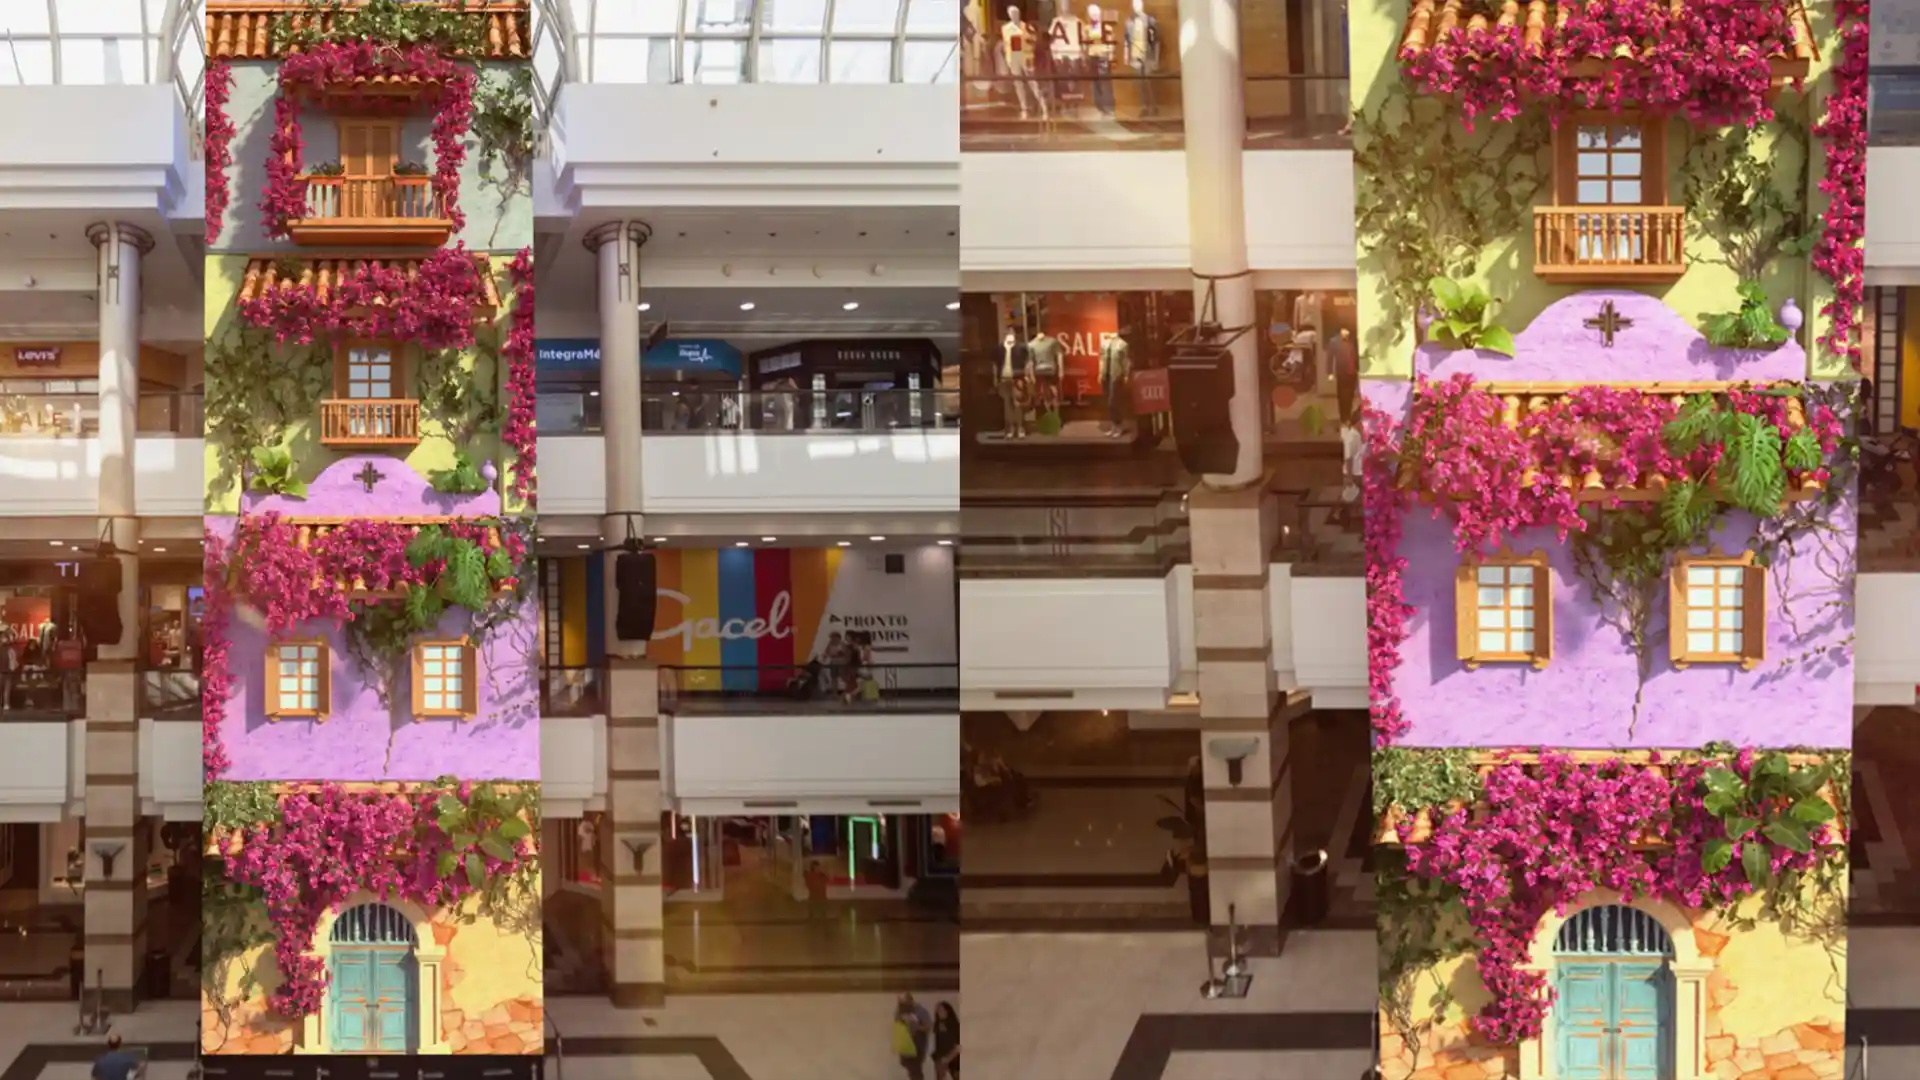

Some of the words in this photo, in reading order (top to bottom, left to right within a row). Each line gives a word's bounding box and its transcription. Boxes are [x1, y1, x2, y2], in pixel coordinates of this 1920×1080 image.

[10, 411, 63, 427] ALE
[651, 587, 790, 652] Gacel
[844, 615, 908, 627] PRONTO
[10, 623, 41, 640] SAL
